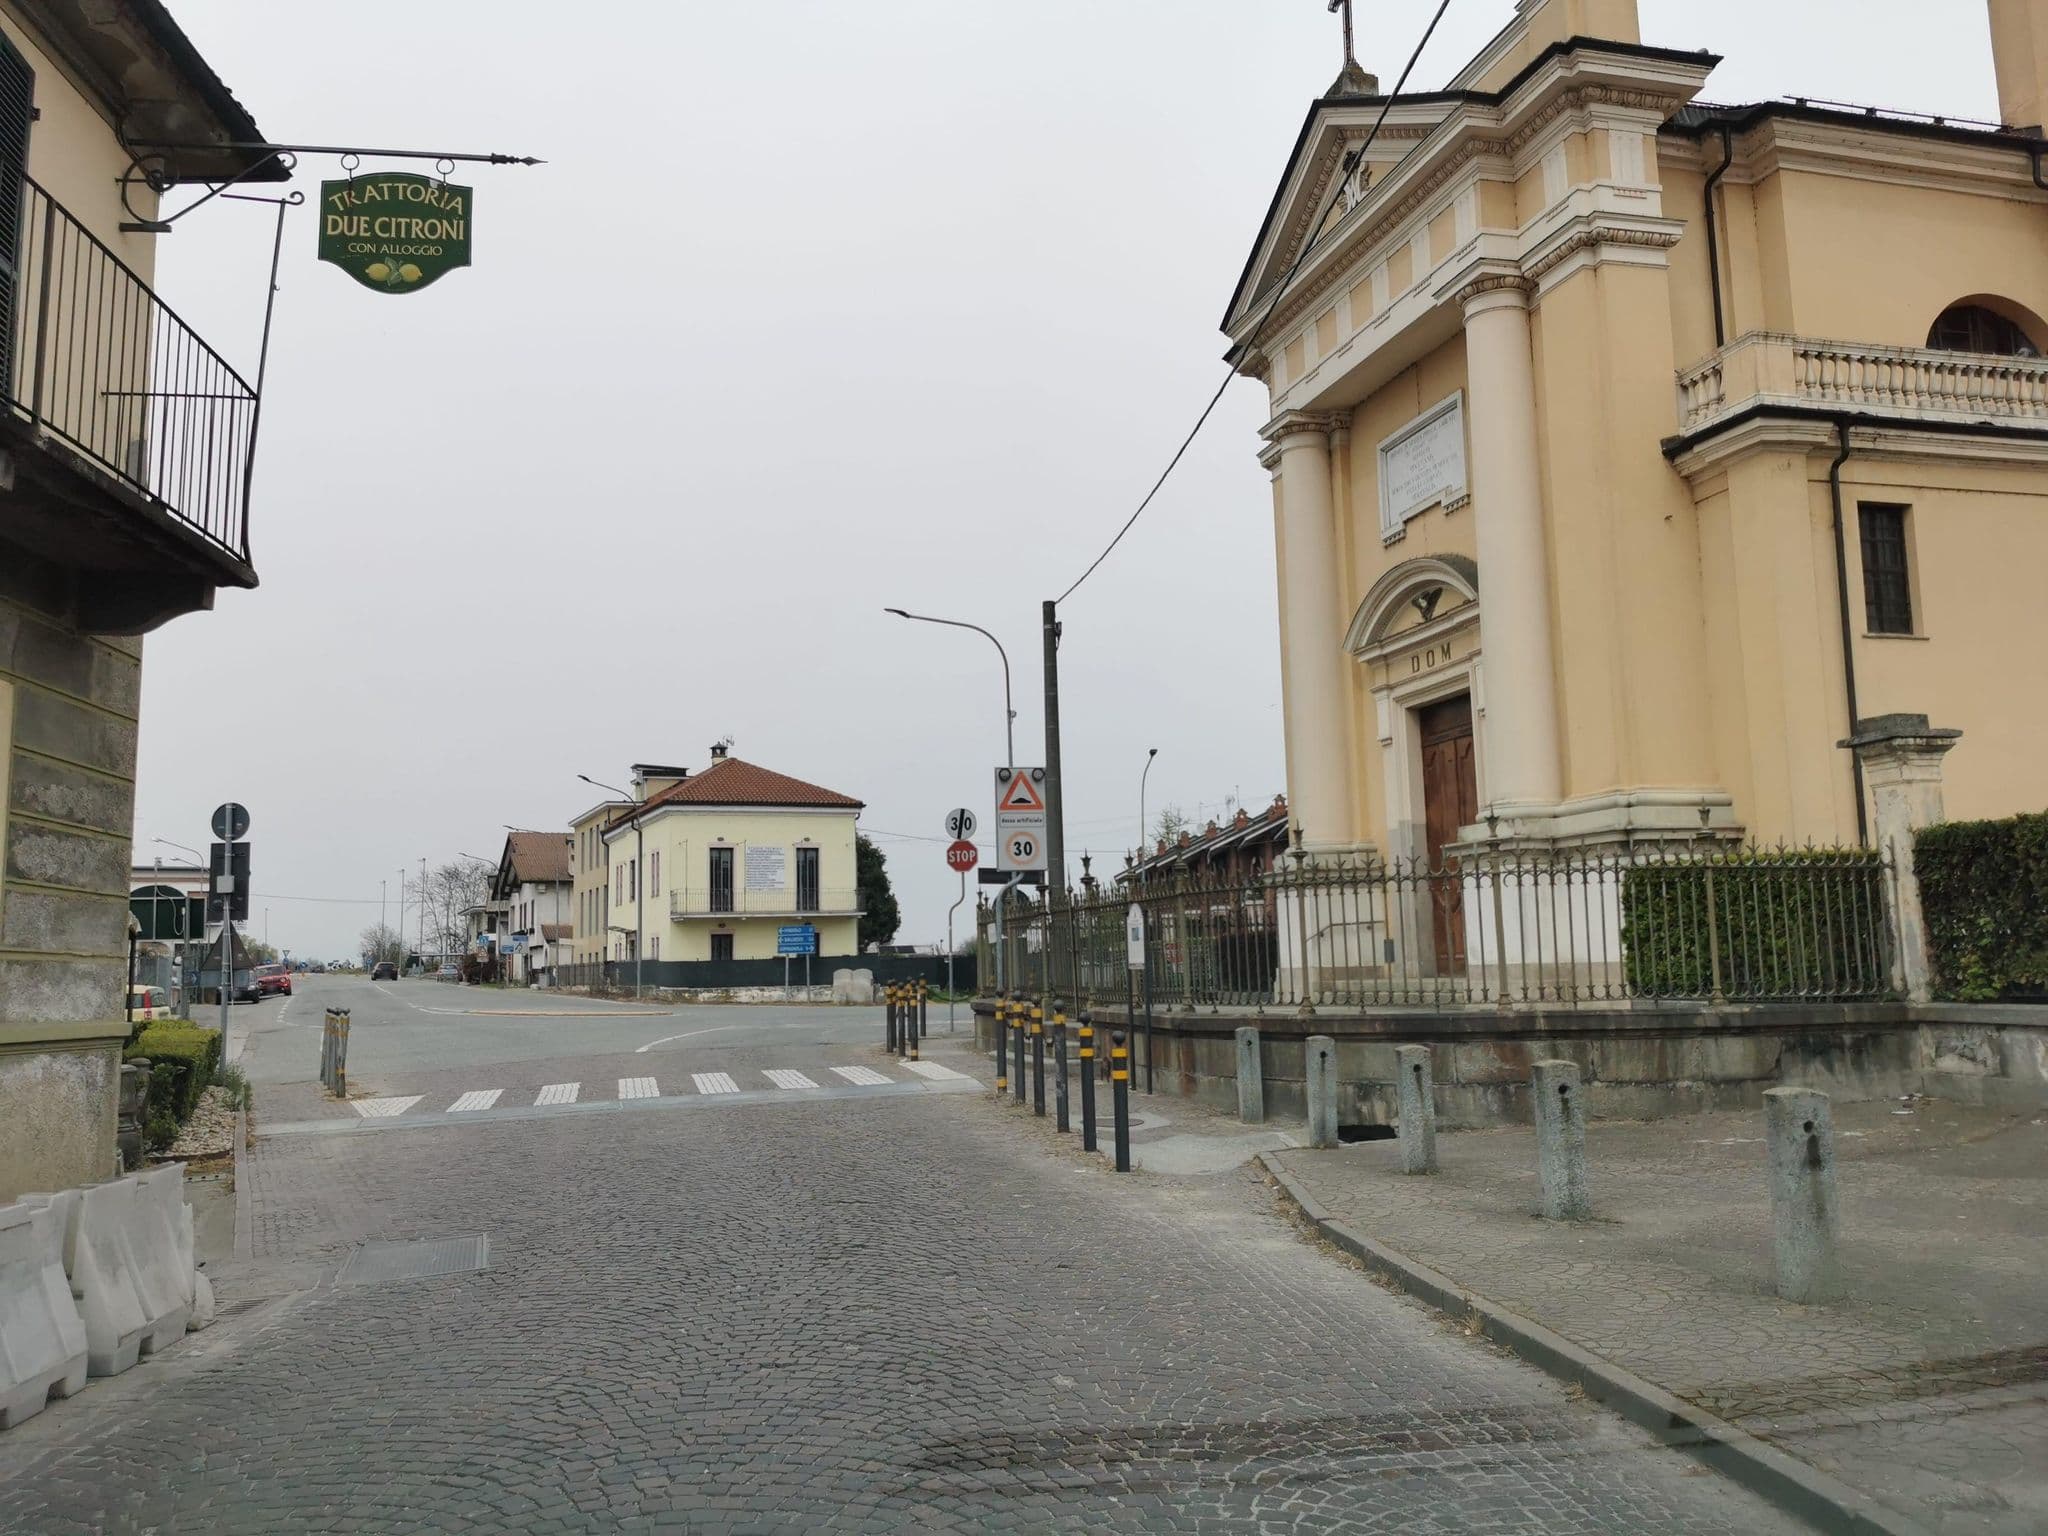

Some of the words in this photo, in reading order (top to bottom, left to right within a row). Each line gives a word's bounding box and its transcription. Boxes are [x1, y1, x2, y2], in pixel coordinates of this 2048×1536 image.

[329, 183, 463, 215] TRATTORIA
[327, 215, 370, 237] DUE
[374, 217, 464, 240] CITRONI
[348, 242, 377, 253] CON
[380, 243, 443, 256] ALLOGGIO
[951, 817, 972, 831] 30
[1013, 841, 1033, 856] 30
[948, 851, 976, 863] STOP
